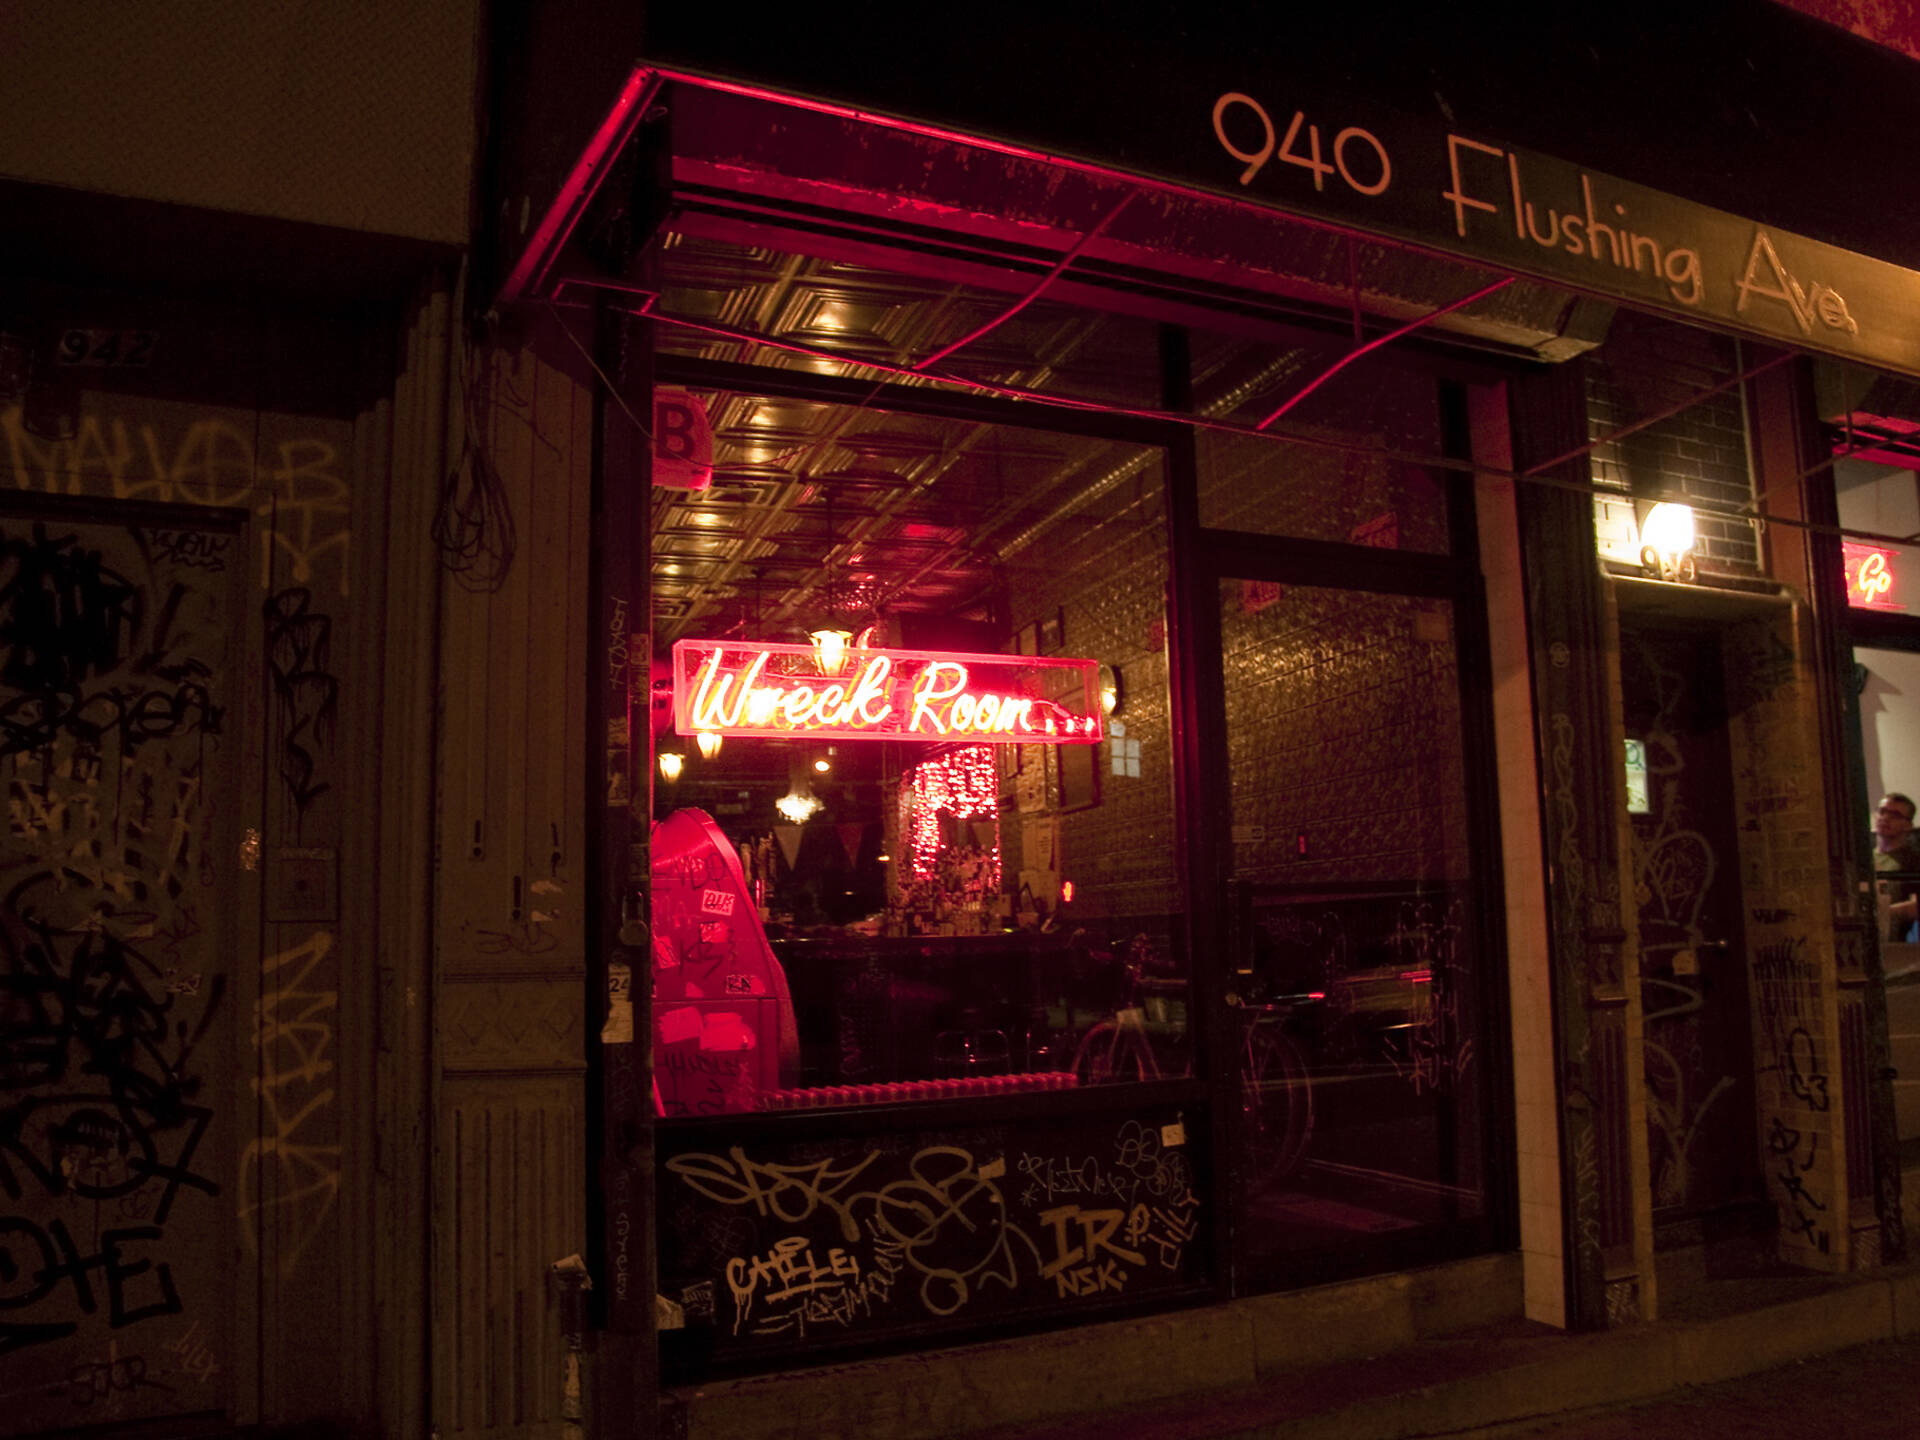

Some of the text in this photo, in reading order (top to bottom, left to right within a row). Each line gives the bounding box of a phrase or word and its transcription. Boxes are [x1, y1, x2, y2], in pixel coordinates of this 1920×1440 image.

[1211, 91, 1392, 197] 940
[1442, 132, 1702, 303] Flushing
[62, 329, 152, 363] 942
[655, 402, 696, 460] B
[1858, 552, 1892, 604] Go
[690, 646, 893, 733] Wreck
